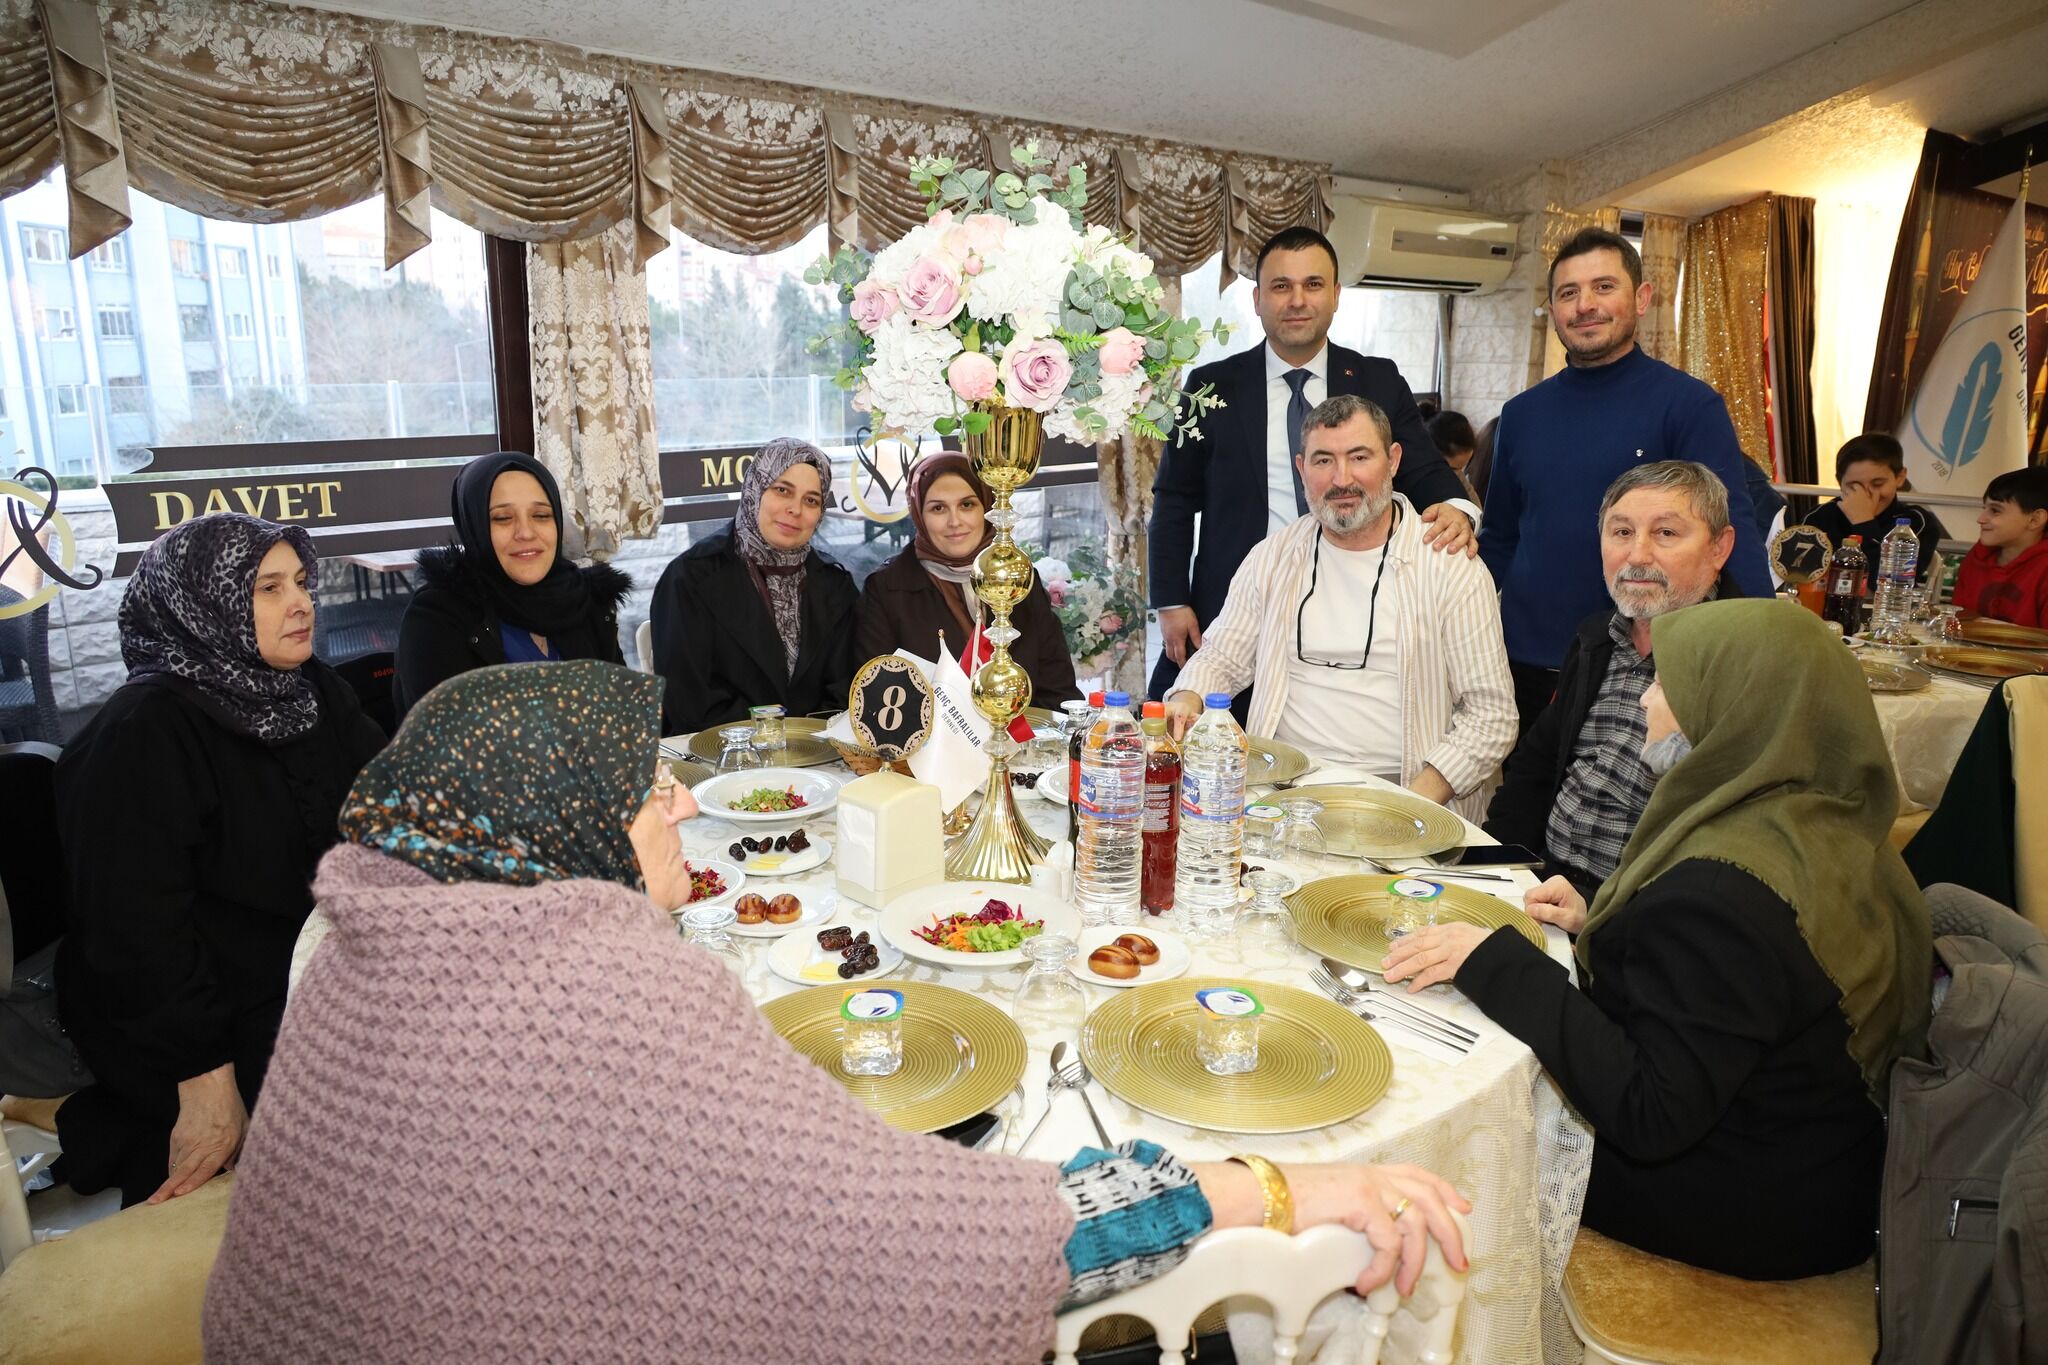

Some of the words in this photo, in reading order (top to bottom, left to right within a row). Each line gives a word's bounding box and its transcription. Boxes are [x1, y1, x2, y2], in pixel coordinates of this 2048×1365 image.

[150, 481, 342, 530] DAVET
[1791, 542, 1815, 568] 7
[877, 685, 907, 731] 8
[933, 686, 951, 708] GENÇ
[948, 705, 981, 748] BAFRALILAR
